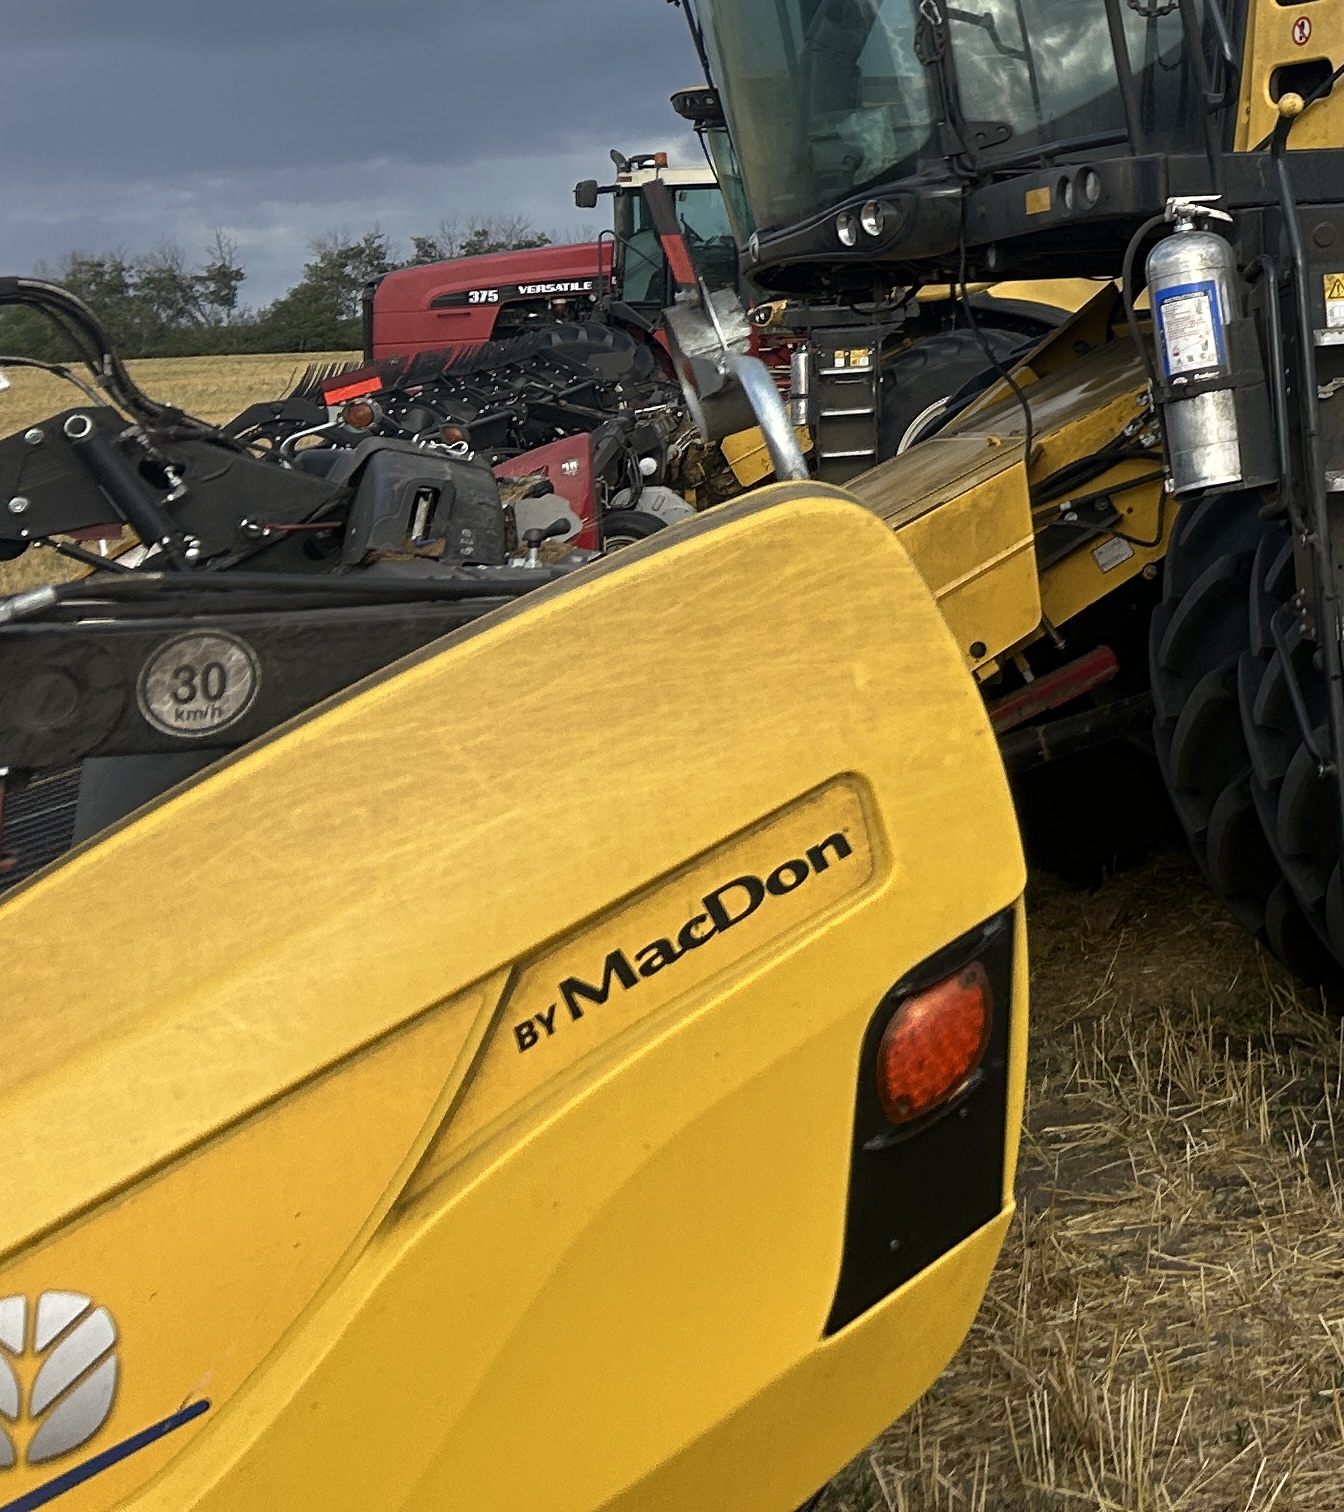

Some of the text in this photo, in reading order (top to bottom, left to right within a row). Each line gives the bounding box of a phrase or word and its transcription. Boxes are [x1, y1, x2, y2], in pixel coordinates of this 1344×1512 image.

[468, 289, 499, 304] 375
[518, 281, 593, 295] VERSATILE
[170, 661, 226, 705] 30
[173, 703, 222, 723] km/h
[512, 831, 853, 1054] BY MacDon
